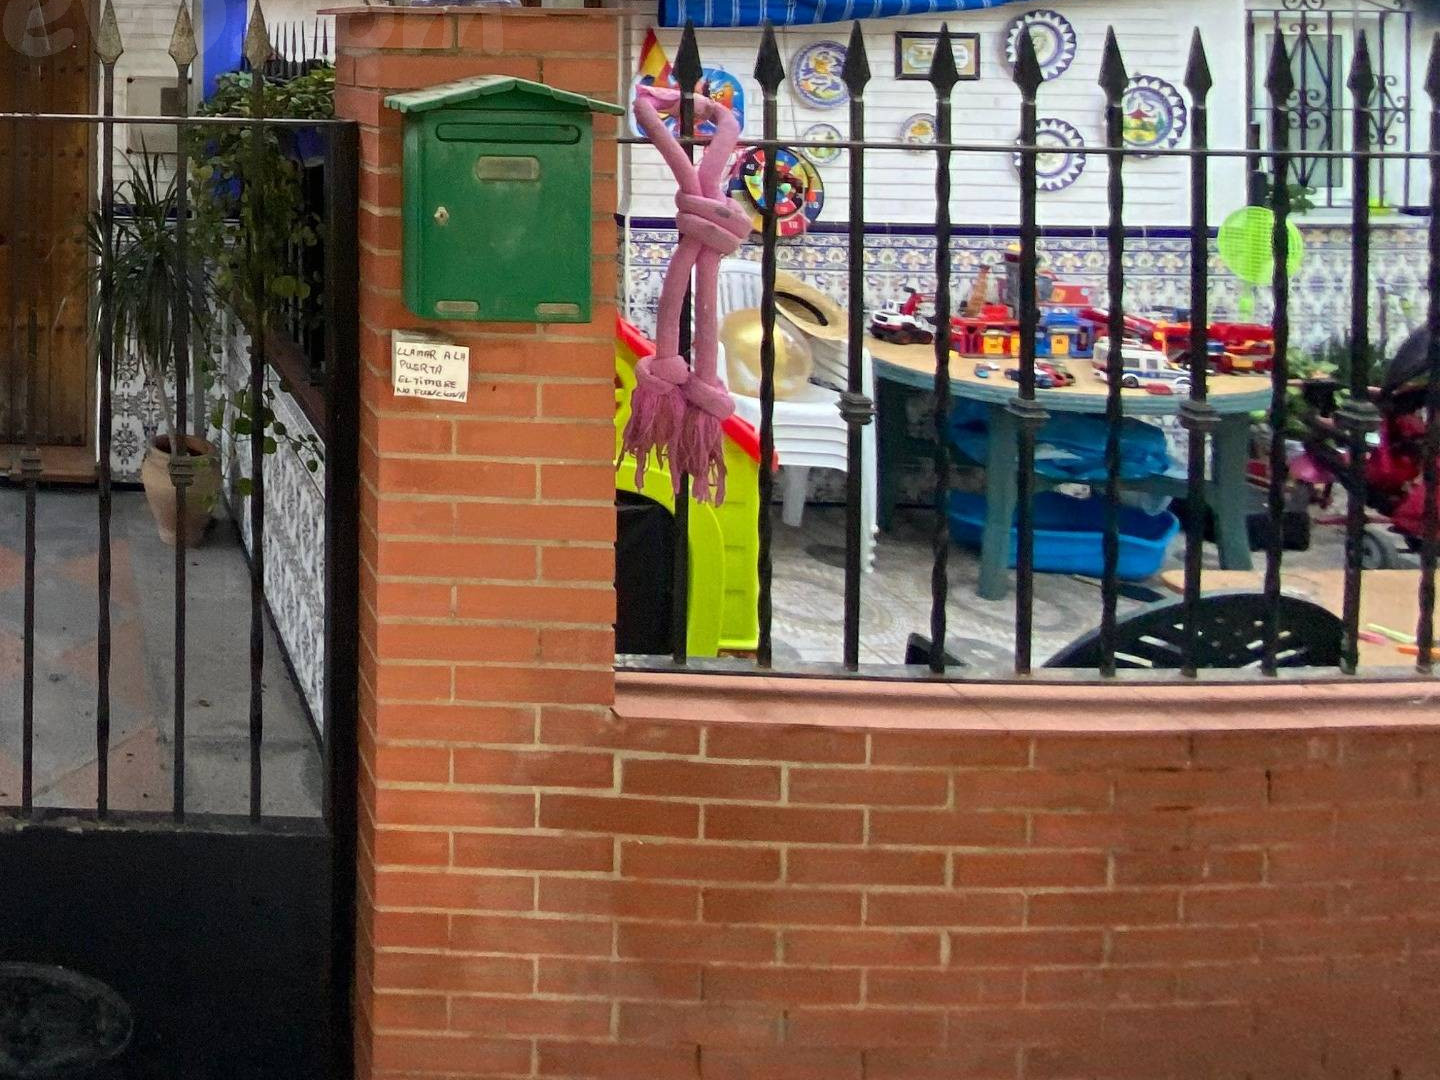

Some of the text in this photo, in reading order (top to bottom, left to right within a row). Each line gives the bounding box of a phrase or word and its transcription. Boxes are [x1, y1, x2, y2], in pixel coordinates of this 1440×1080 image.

[397, 348, 436, 360] LLAMAR
[444, 351, 450, 360] A
[400, 360, 442, 374] PUERTA
[398, 375, 412, 383] EL
